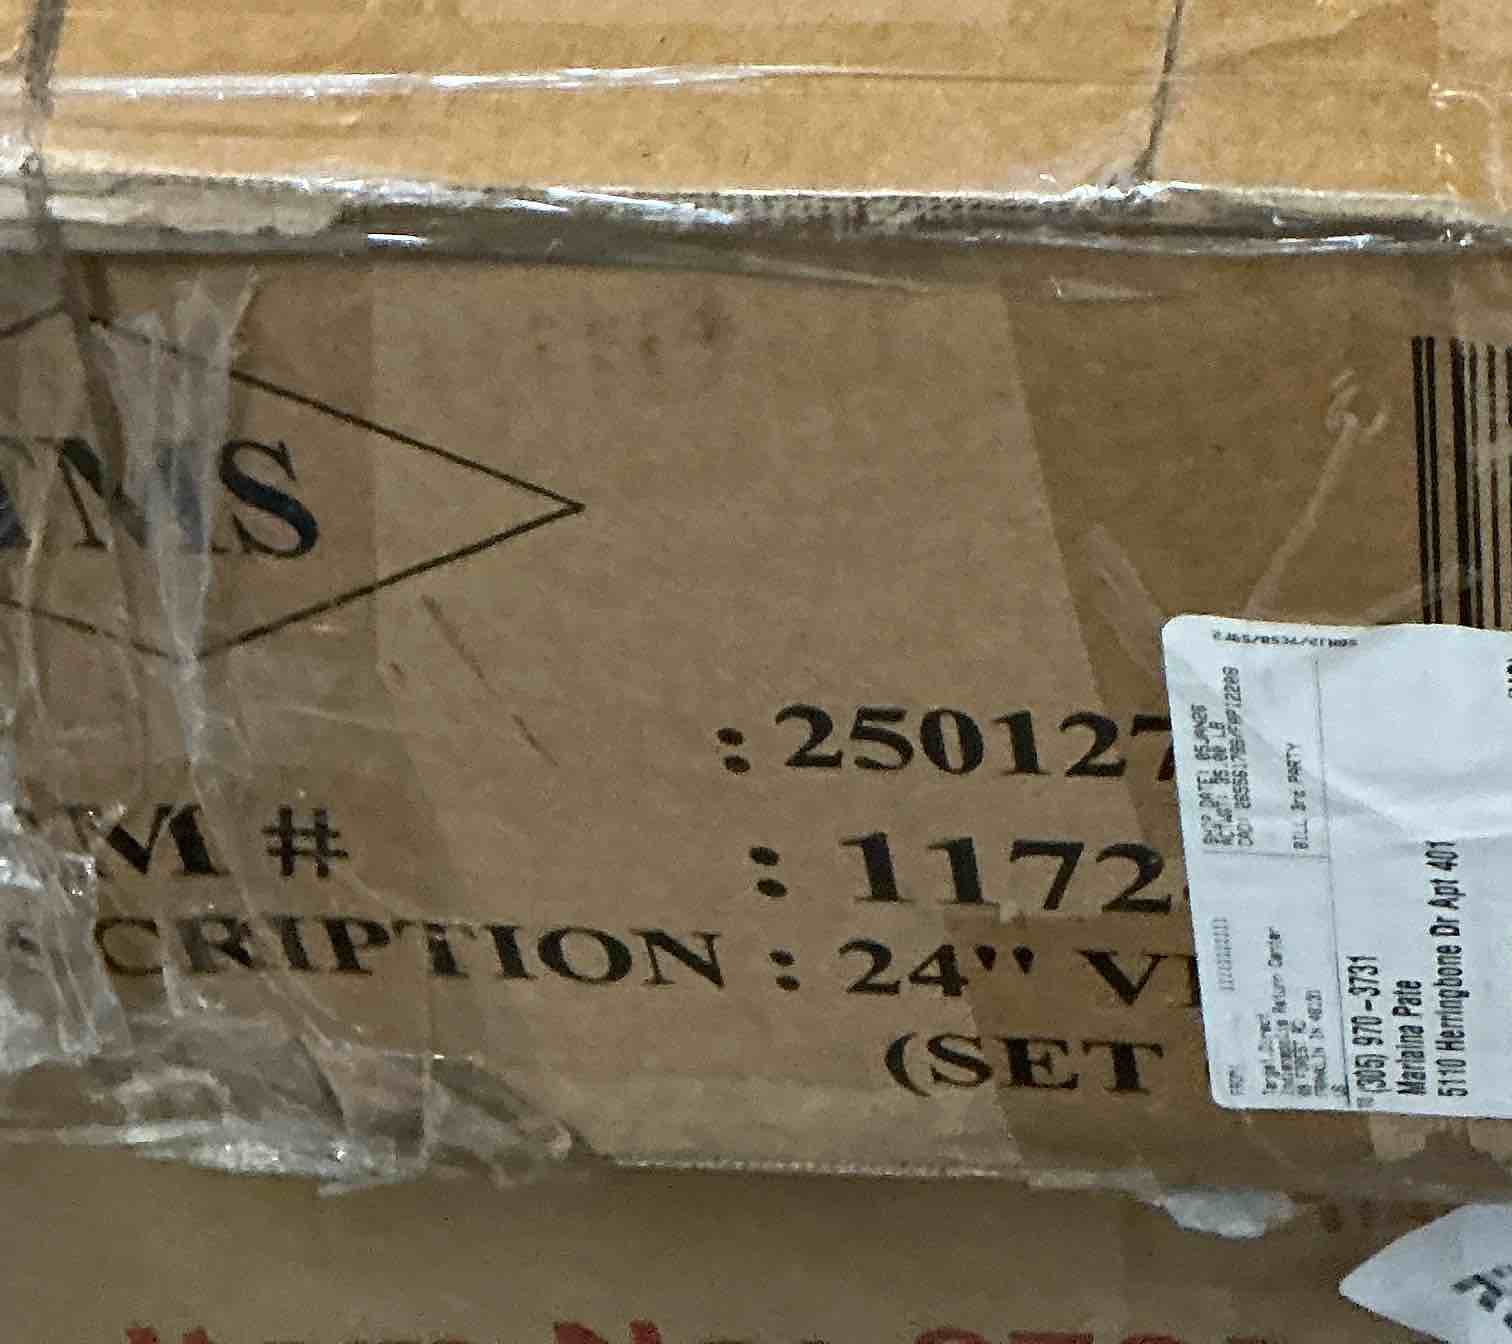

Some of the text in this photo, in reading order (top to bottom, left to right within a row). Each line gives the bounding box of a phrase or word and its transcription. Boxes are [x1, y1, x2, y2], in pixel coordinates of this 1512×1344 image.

[774, 703, 1176, 780] 250127
[1285, 742, 1304, 784] PARTY
[262, 804, 349, 879] #
[1292, 819, 1309, 850] BILL
[838, 831, 1192, 913] 1172
[1391, 979, 1424, 1017] Pate
[1424, 839, 1470, 1097] 5110 Herringbone Dr Apt 401
[884, 1031, 1166, 1098] (SET
[1352, 1053, 1390, 1095] (305)
